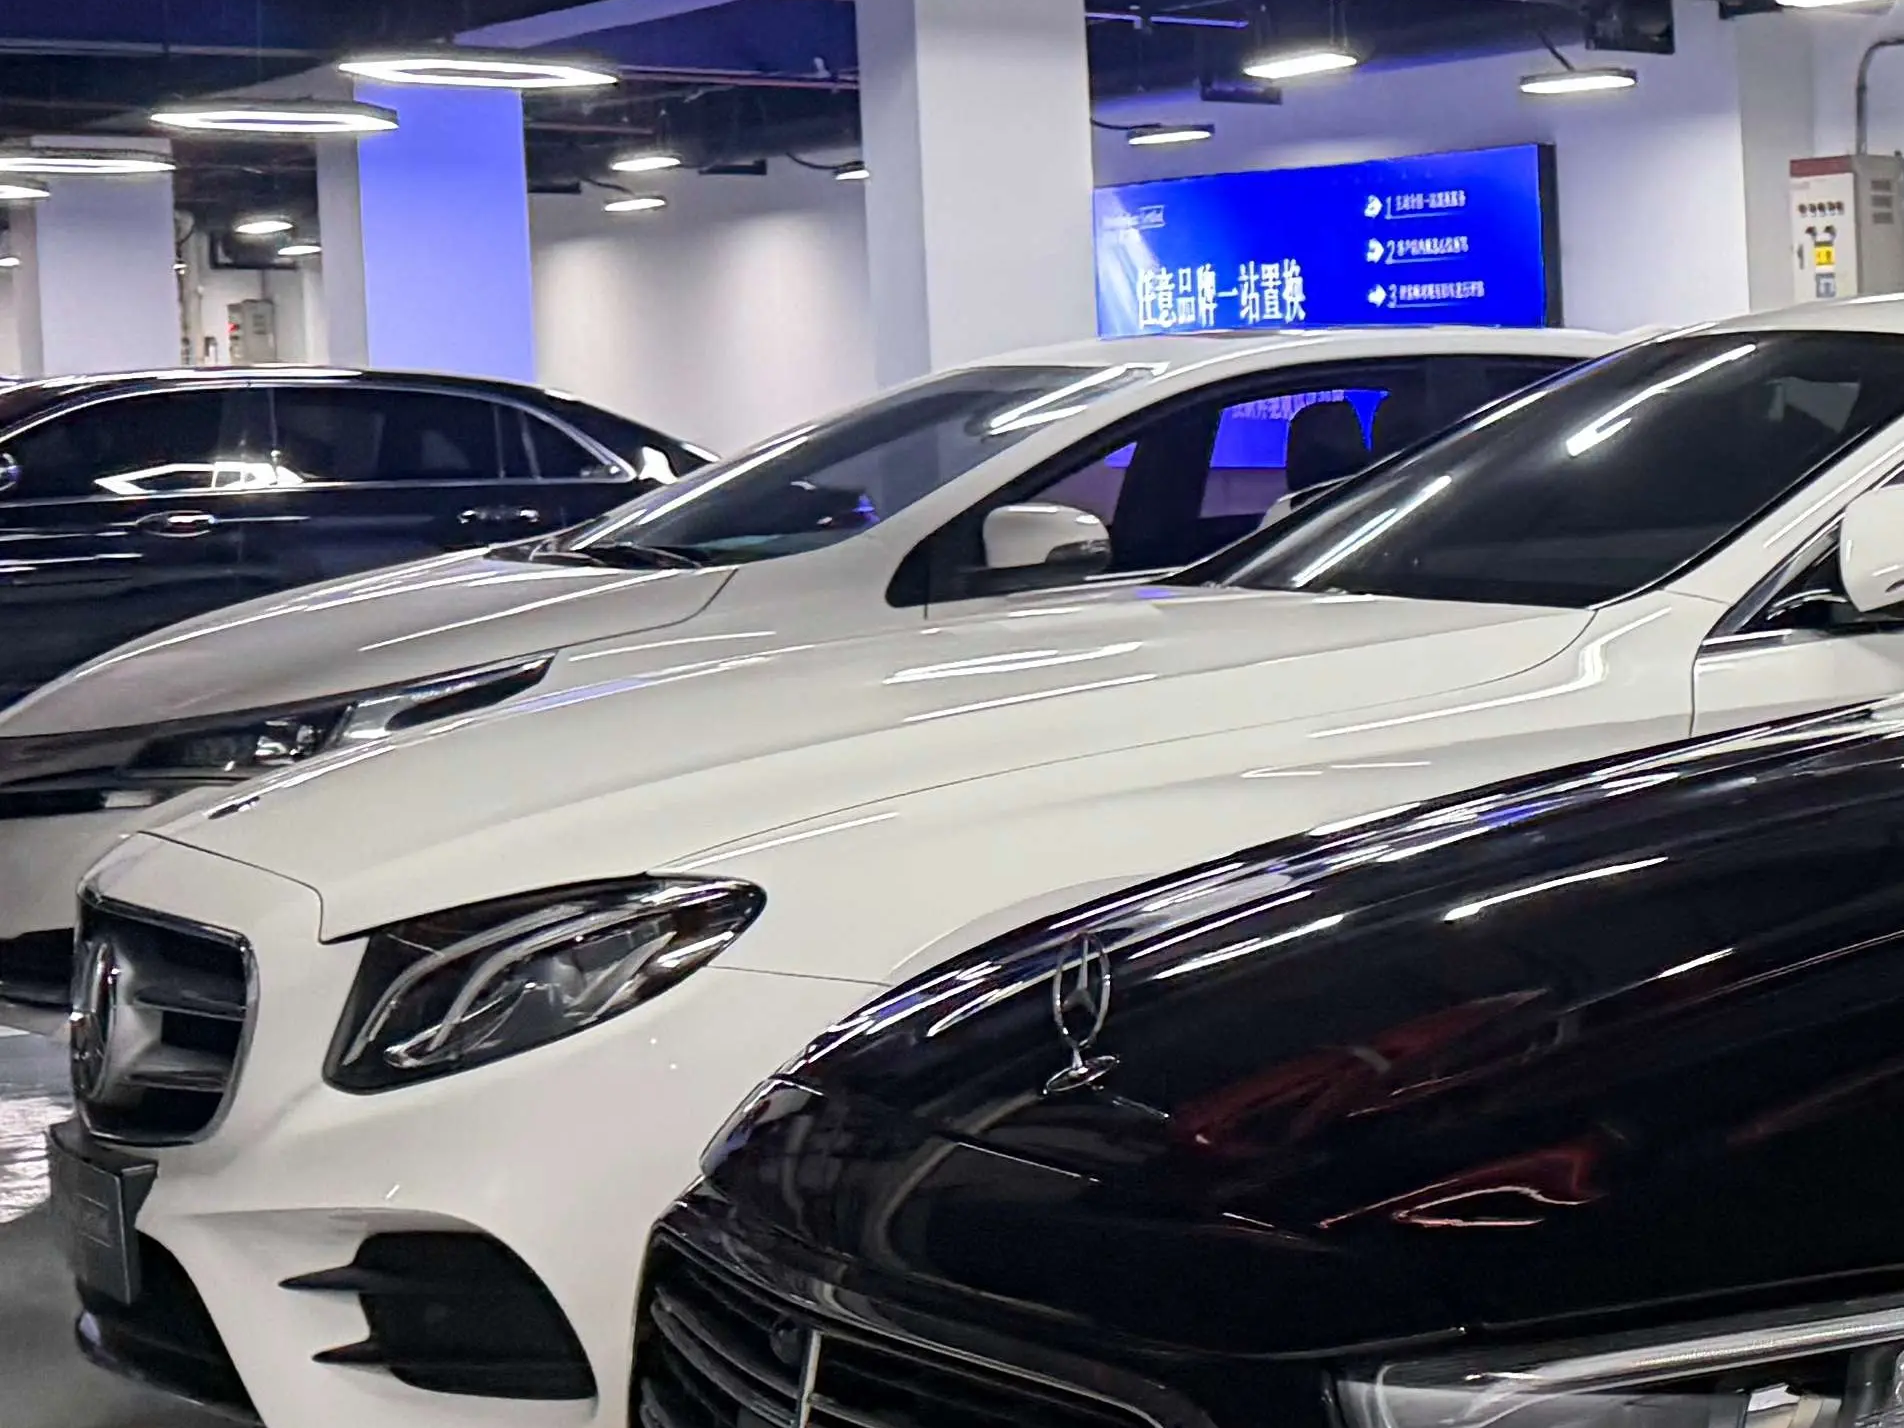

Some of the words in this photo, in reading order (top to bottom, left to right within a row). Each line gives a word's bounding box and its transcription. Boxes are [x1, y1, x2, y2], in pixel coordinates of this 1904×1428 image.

[1136, 259, 1305, 329] 任意品牌一站置换
